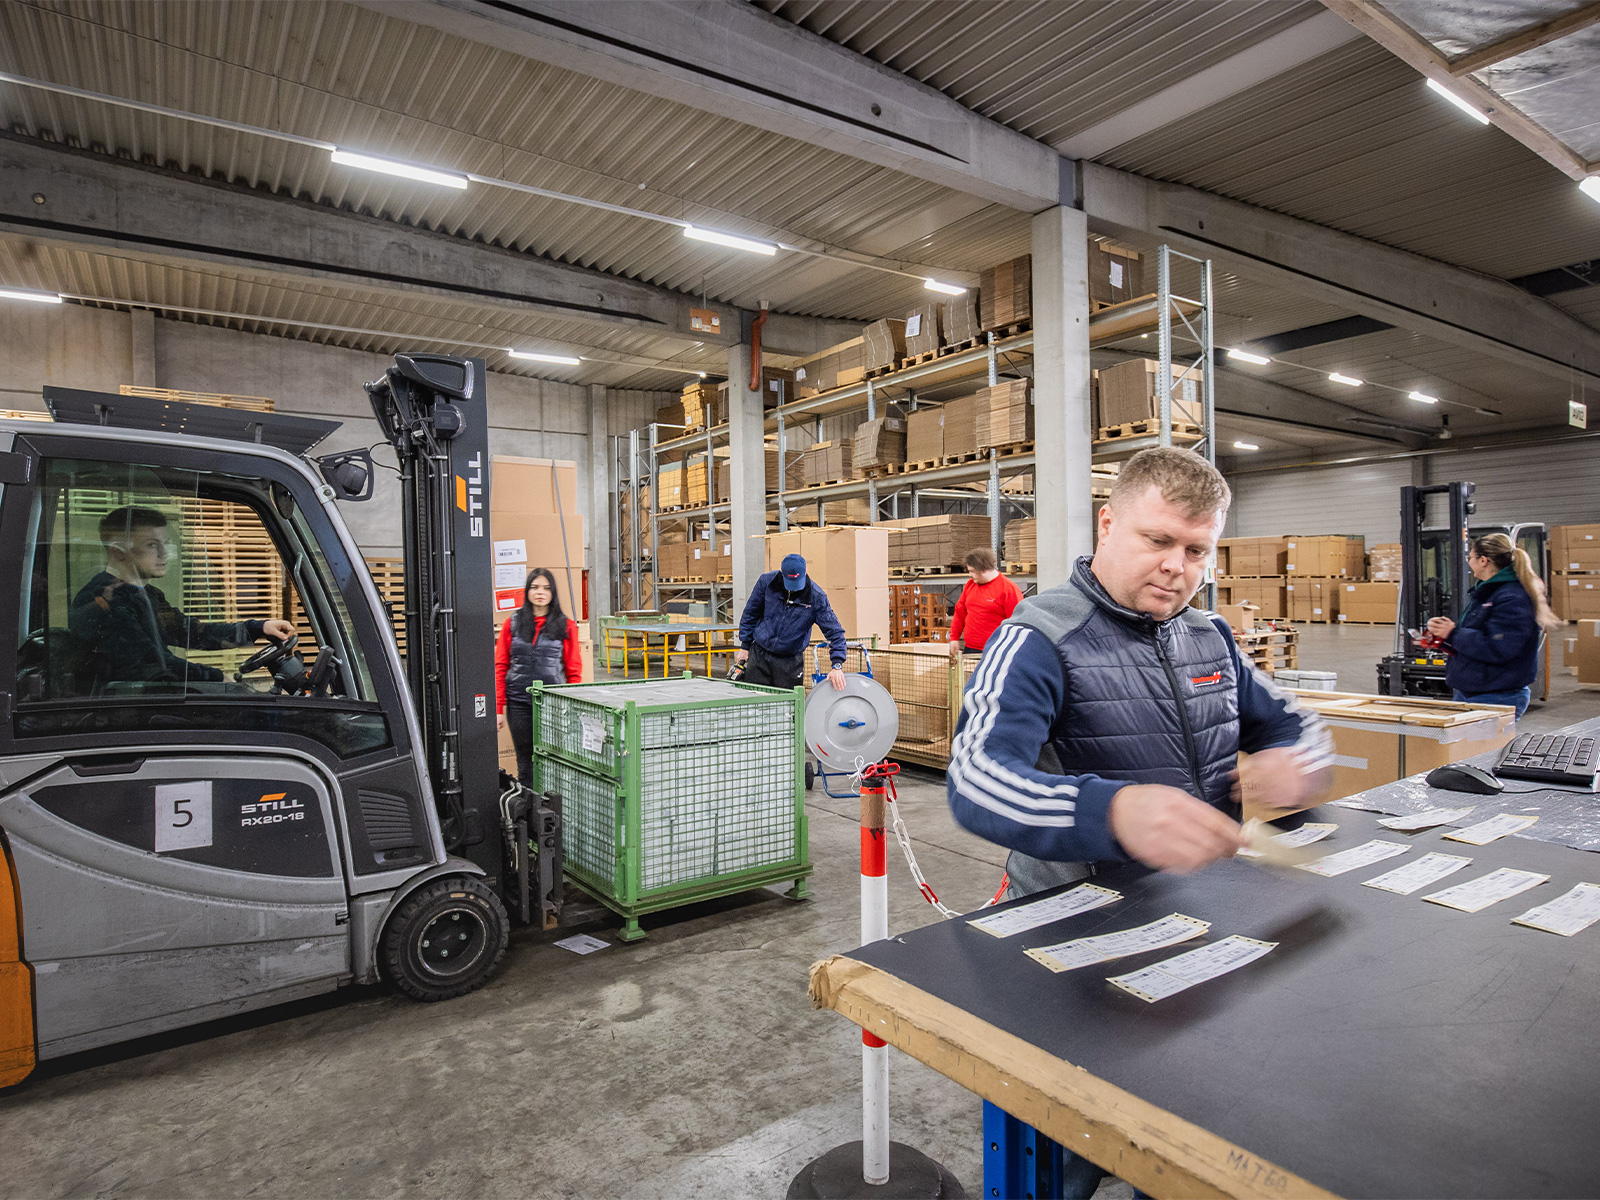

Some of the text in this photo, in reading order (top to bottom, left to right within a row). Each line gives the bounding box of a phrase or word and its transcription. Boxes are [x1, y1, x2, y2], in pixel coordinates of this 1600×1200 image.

[468, 451, 483, 537] STILL
[172, 799, 193, 828] 5
[241, 799, 305, 814] STILL
[241, 812, 304, 826] RX20-18
